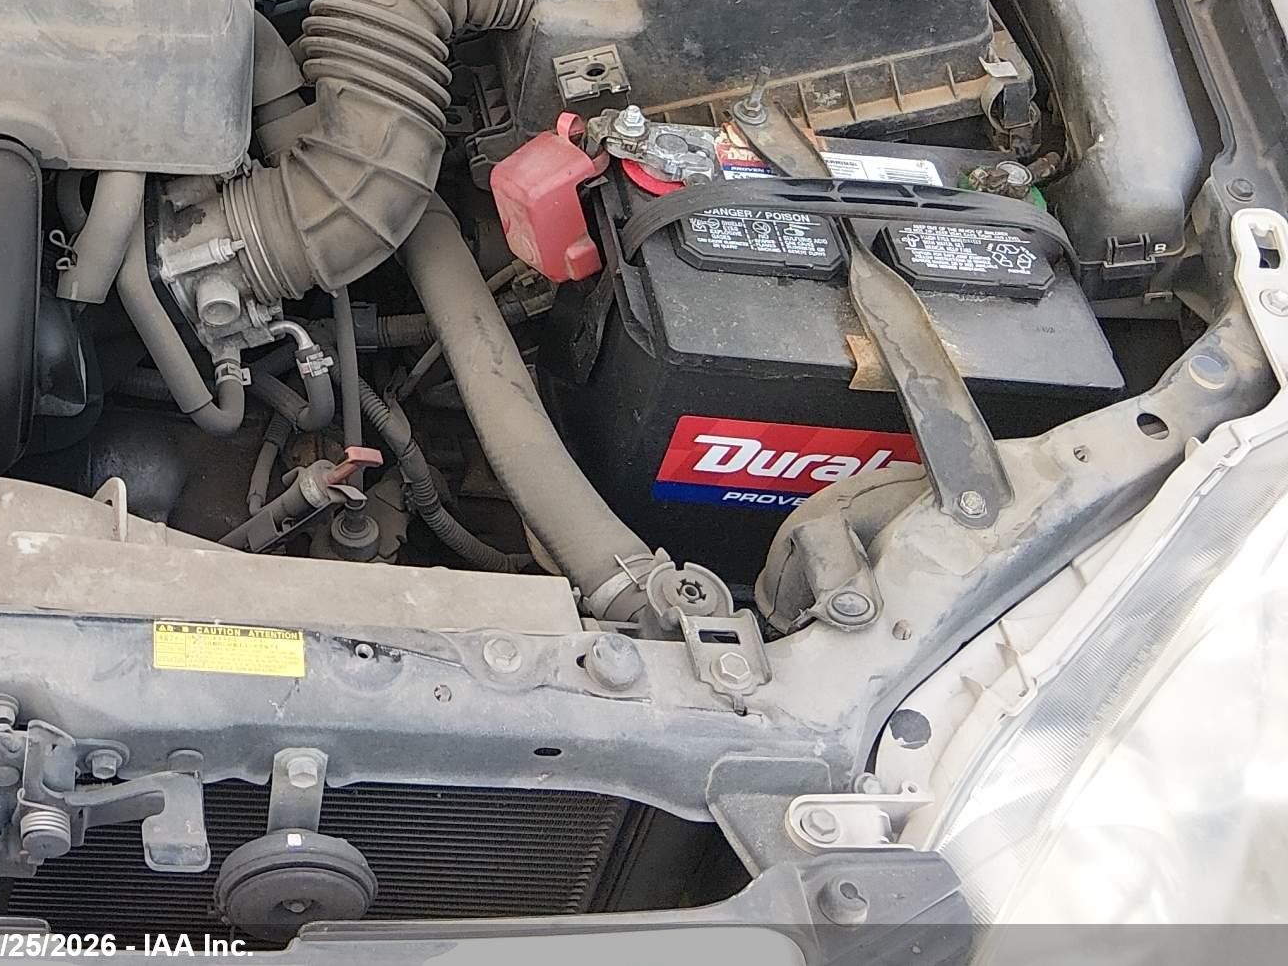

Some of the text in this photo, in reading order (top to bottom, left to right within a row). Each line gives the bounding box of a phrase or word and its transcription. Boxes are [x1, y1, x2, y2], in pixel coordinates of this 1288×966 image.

[765, 211, 810, 223] POISON
[196, 623, 241, 637] CAUTION
[248, 629, 298, 640] ATTENTION
